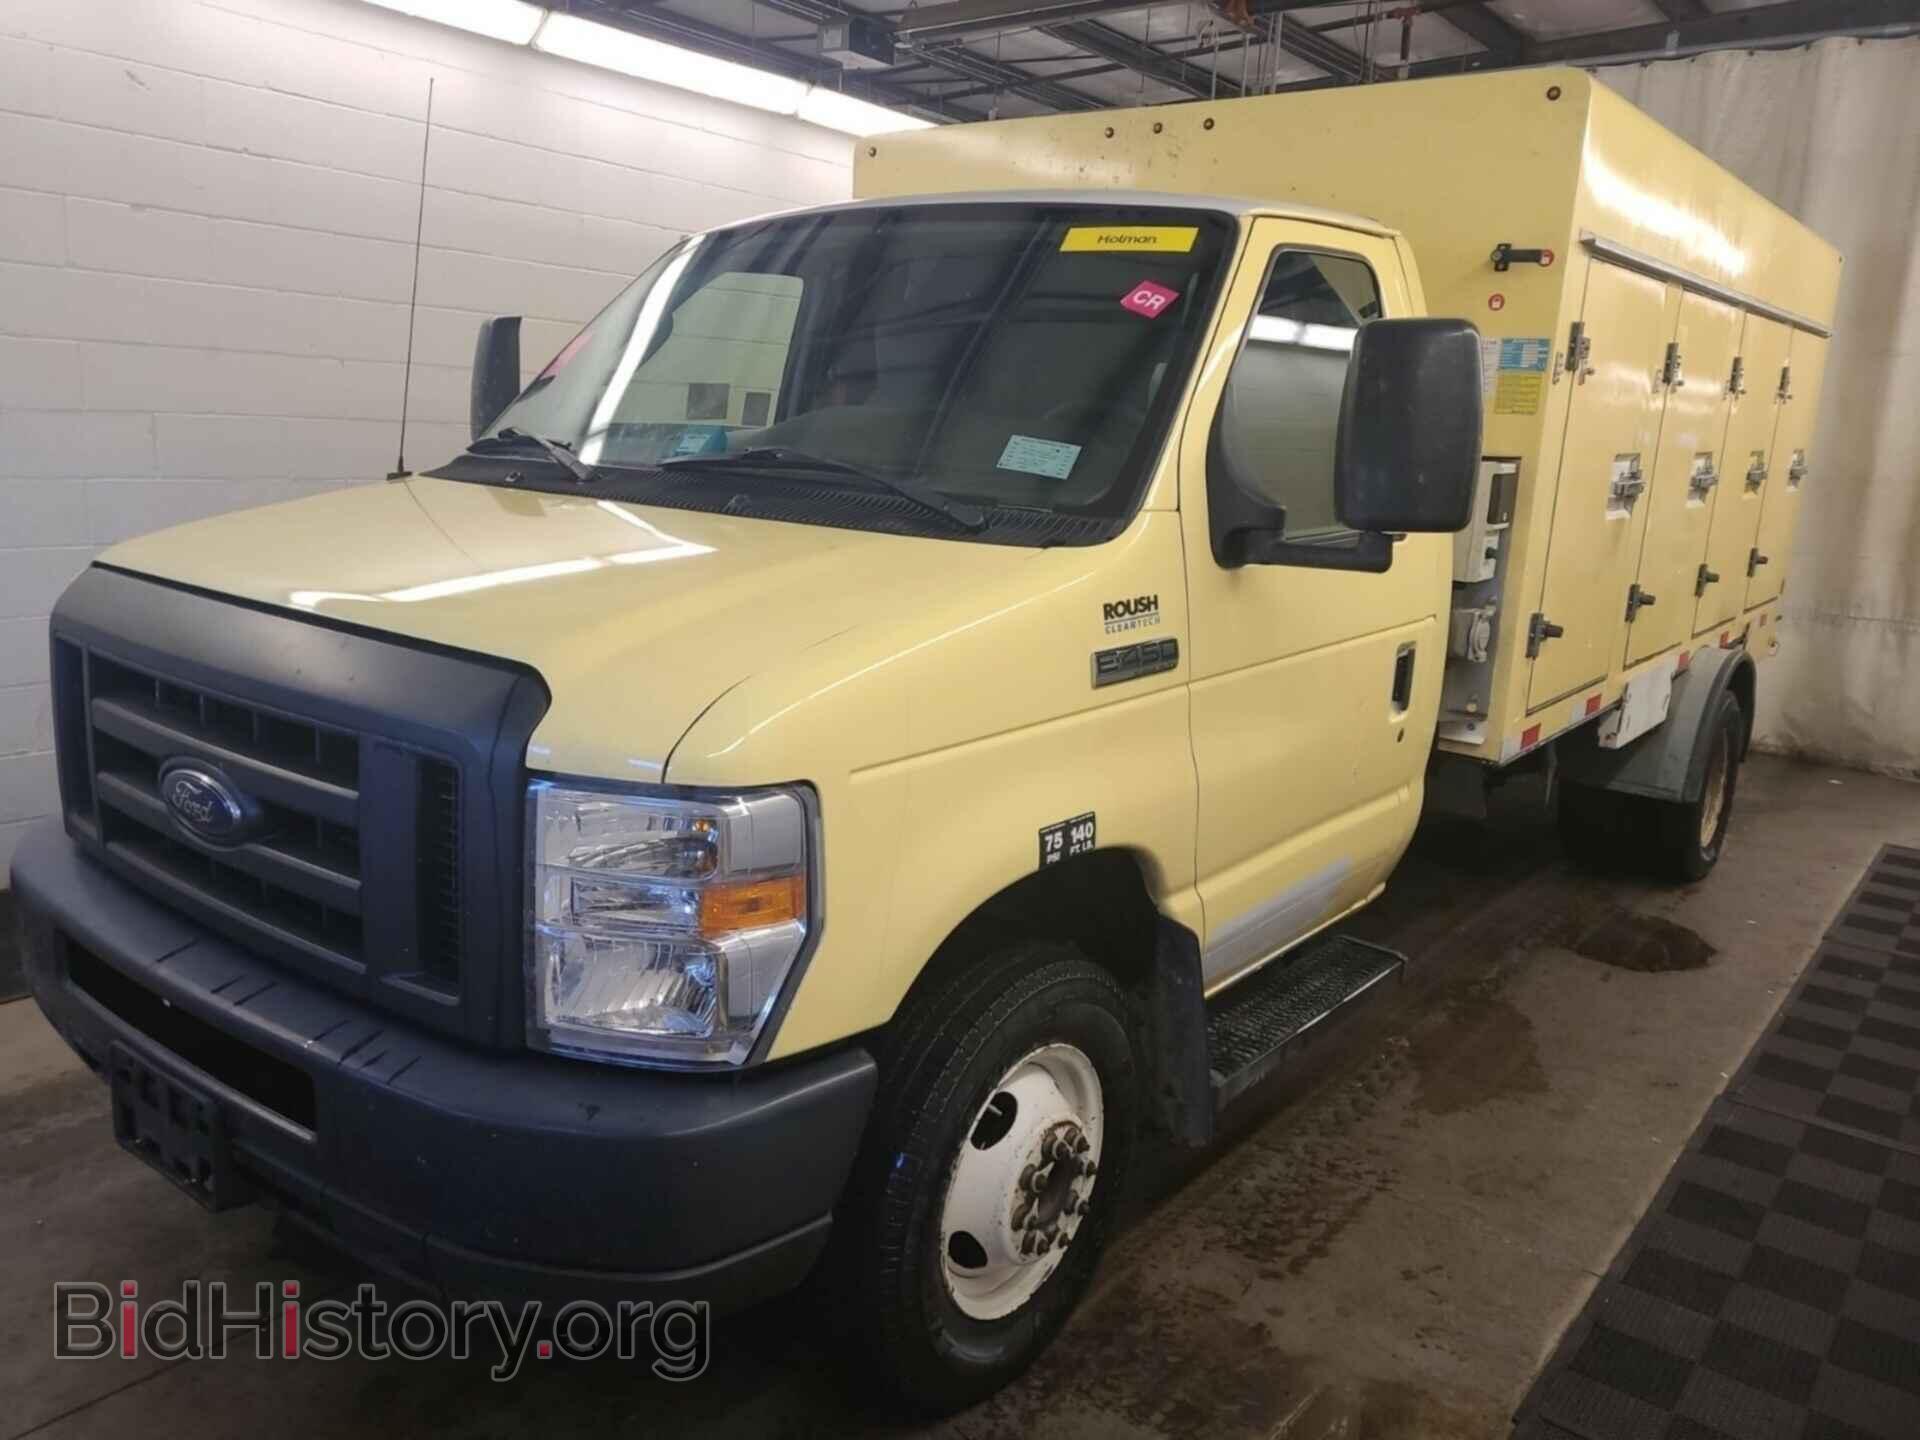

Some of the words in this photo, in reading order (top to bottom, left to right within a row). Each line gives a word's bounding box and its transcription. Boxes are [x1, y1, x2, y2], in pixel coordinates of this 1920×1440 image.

[1097, 233, 1157, 244] Holman
[1132, 289, 1166, 311] CR
[1103, 594, 1159, 621] ROUSH
[1104, 615, 1161, 635] CLEANTECH
[171, 780, 214, 824] Ford
[1044, 830, 1063, 853] 75
[1070, 821, 1094, 844] 140
